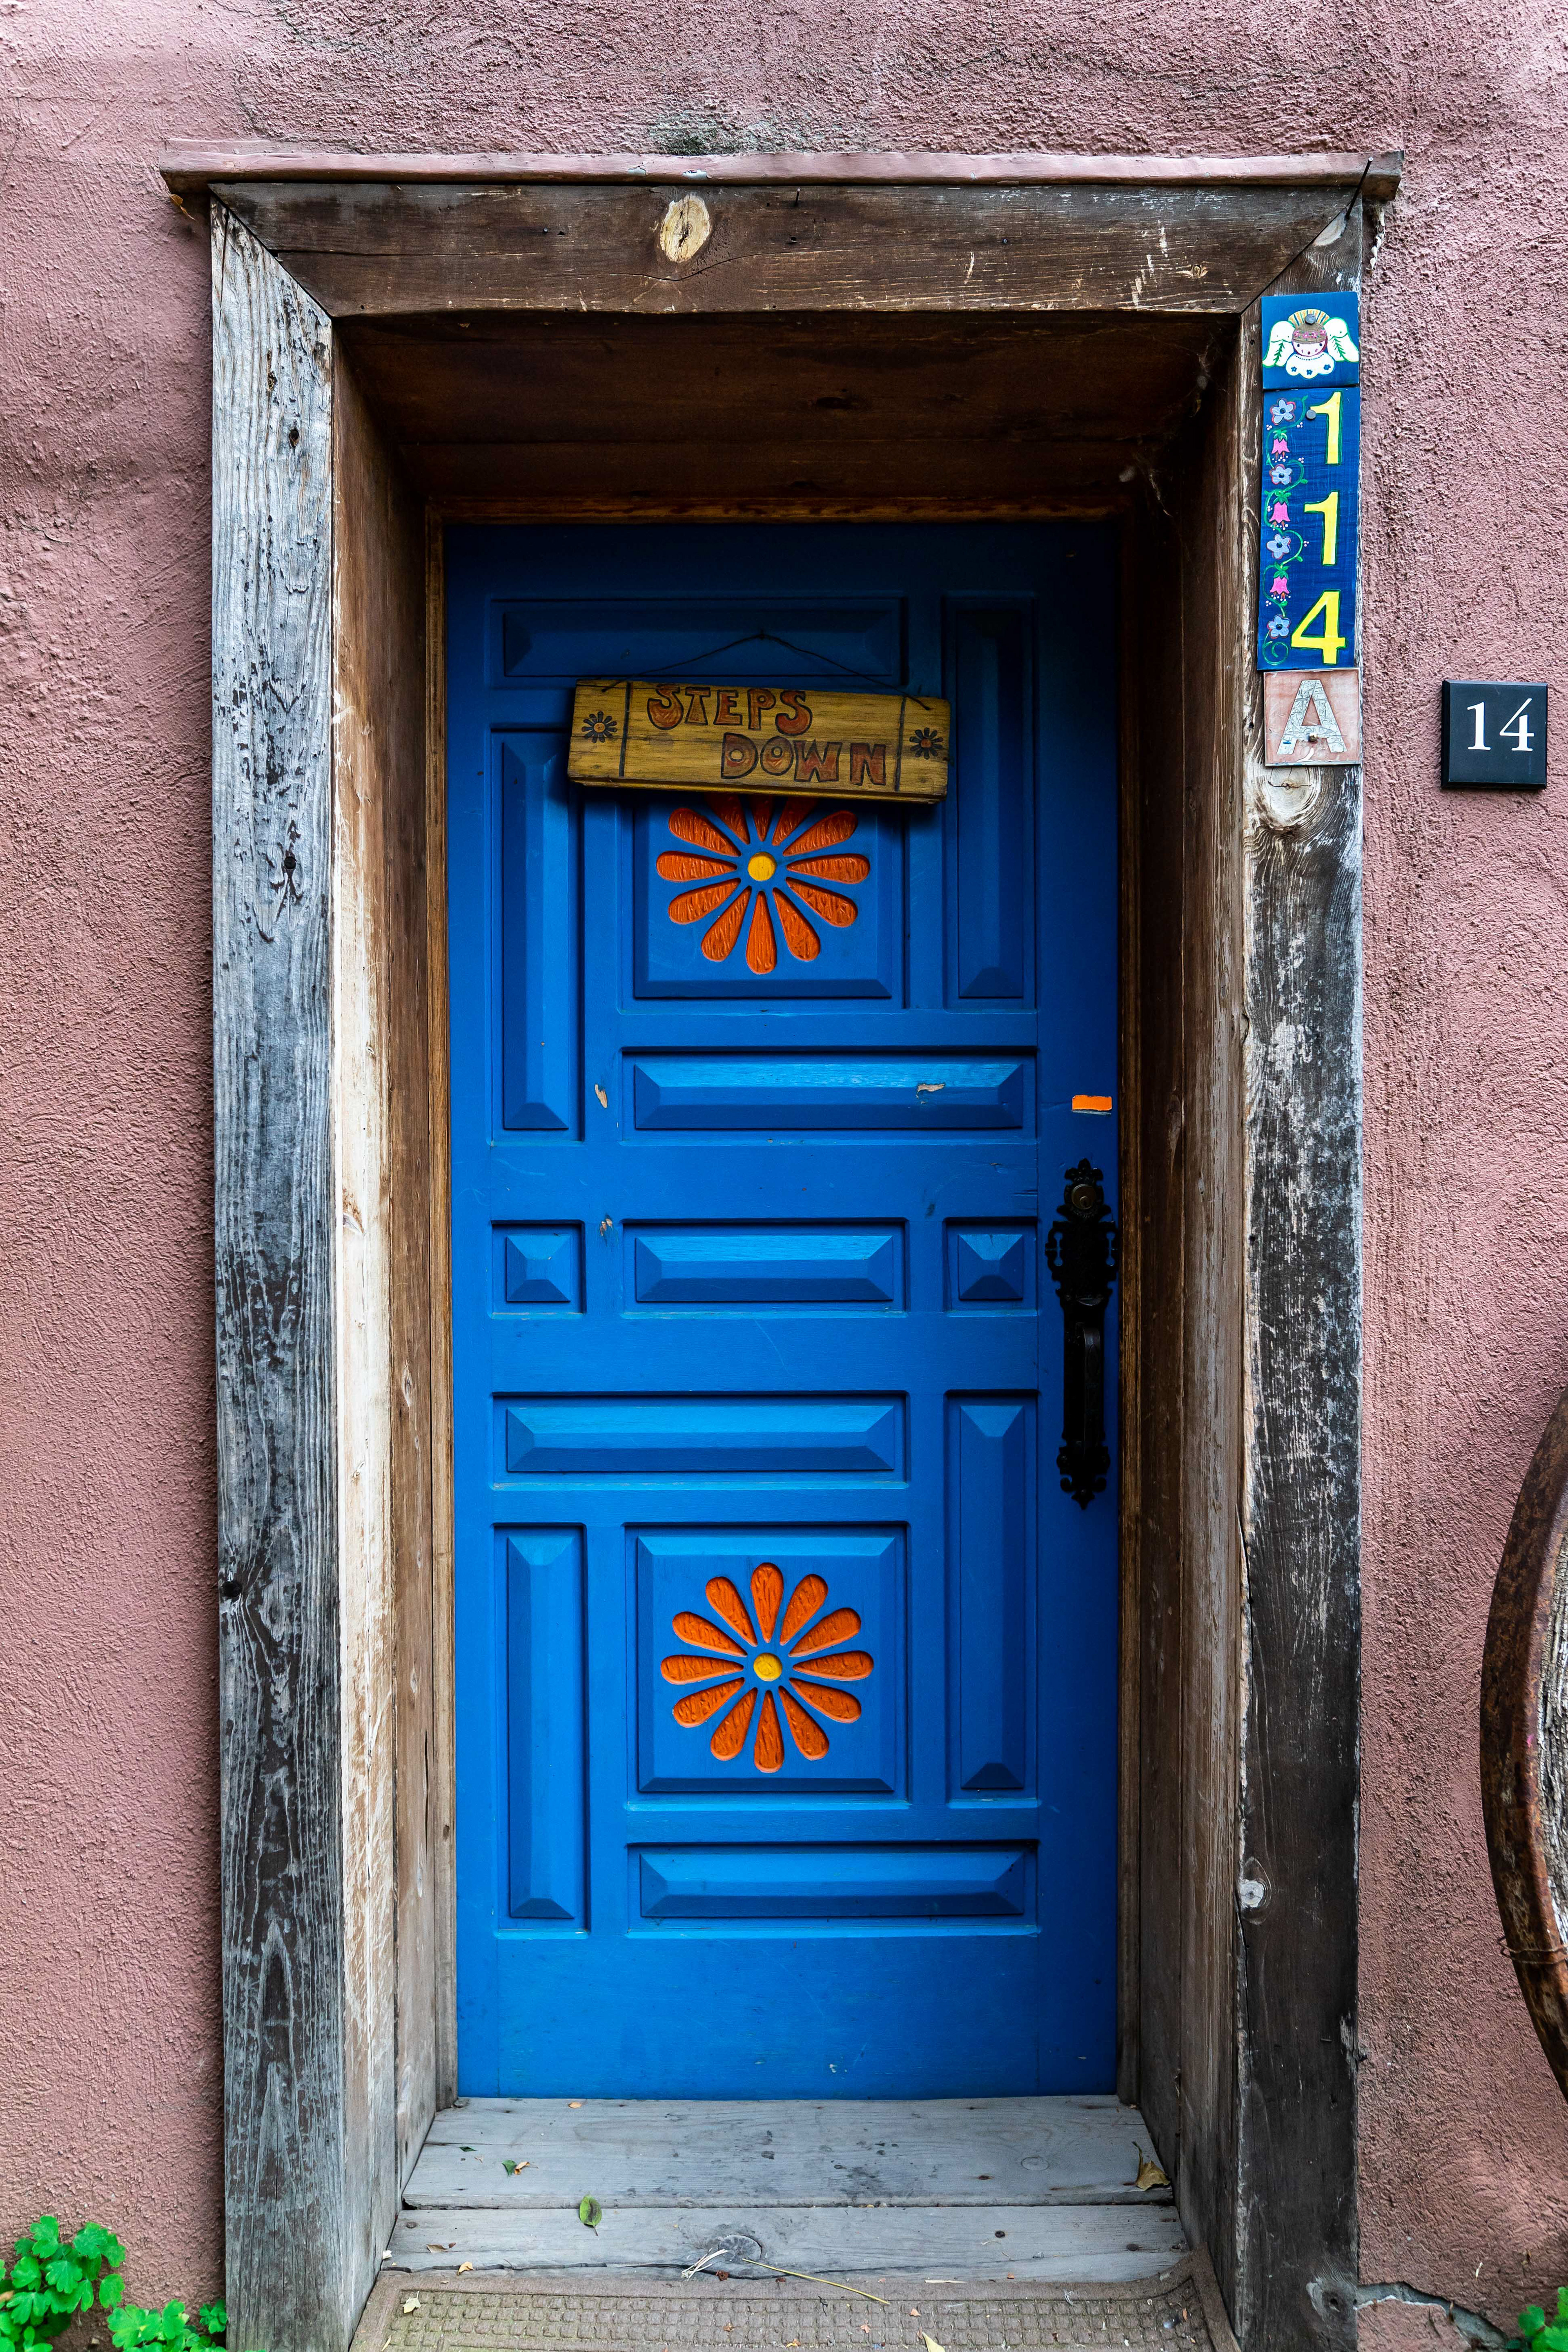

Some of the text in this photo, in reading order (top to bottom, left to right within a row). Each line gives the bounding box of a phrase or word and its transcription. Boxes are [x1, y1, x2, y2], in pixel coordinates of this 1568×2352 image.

[1290, 391, 1348, 665] 114
[646, 684, 813, 735] STEPS
[1276, 679, 1348, 755] A
[1467, 698, 1535, 751] 14
[720, 732, 887, 786] DOWN
